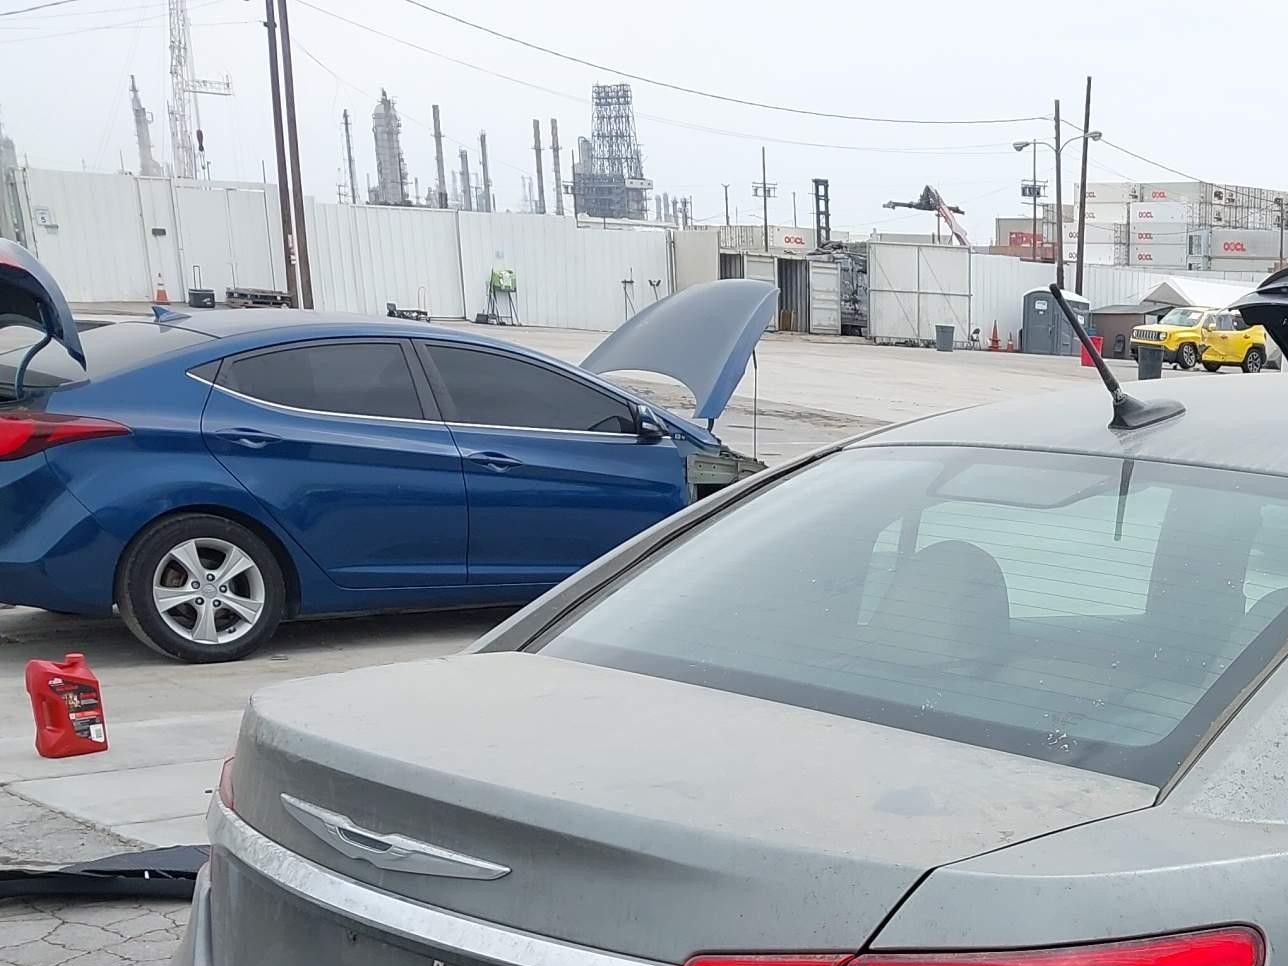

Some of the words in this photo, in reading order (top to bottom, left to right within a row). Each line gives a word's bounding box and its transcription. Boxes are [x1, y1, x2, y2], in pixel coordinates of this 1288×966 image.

[784, 235, 806, 245] OOCL
[1223, 241, 1247, 252] OOCL
[1137, 253, 1153, 261] OOCL
